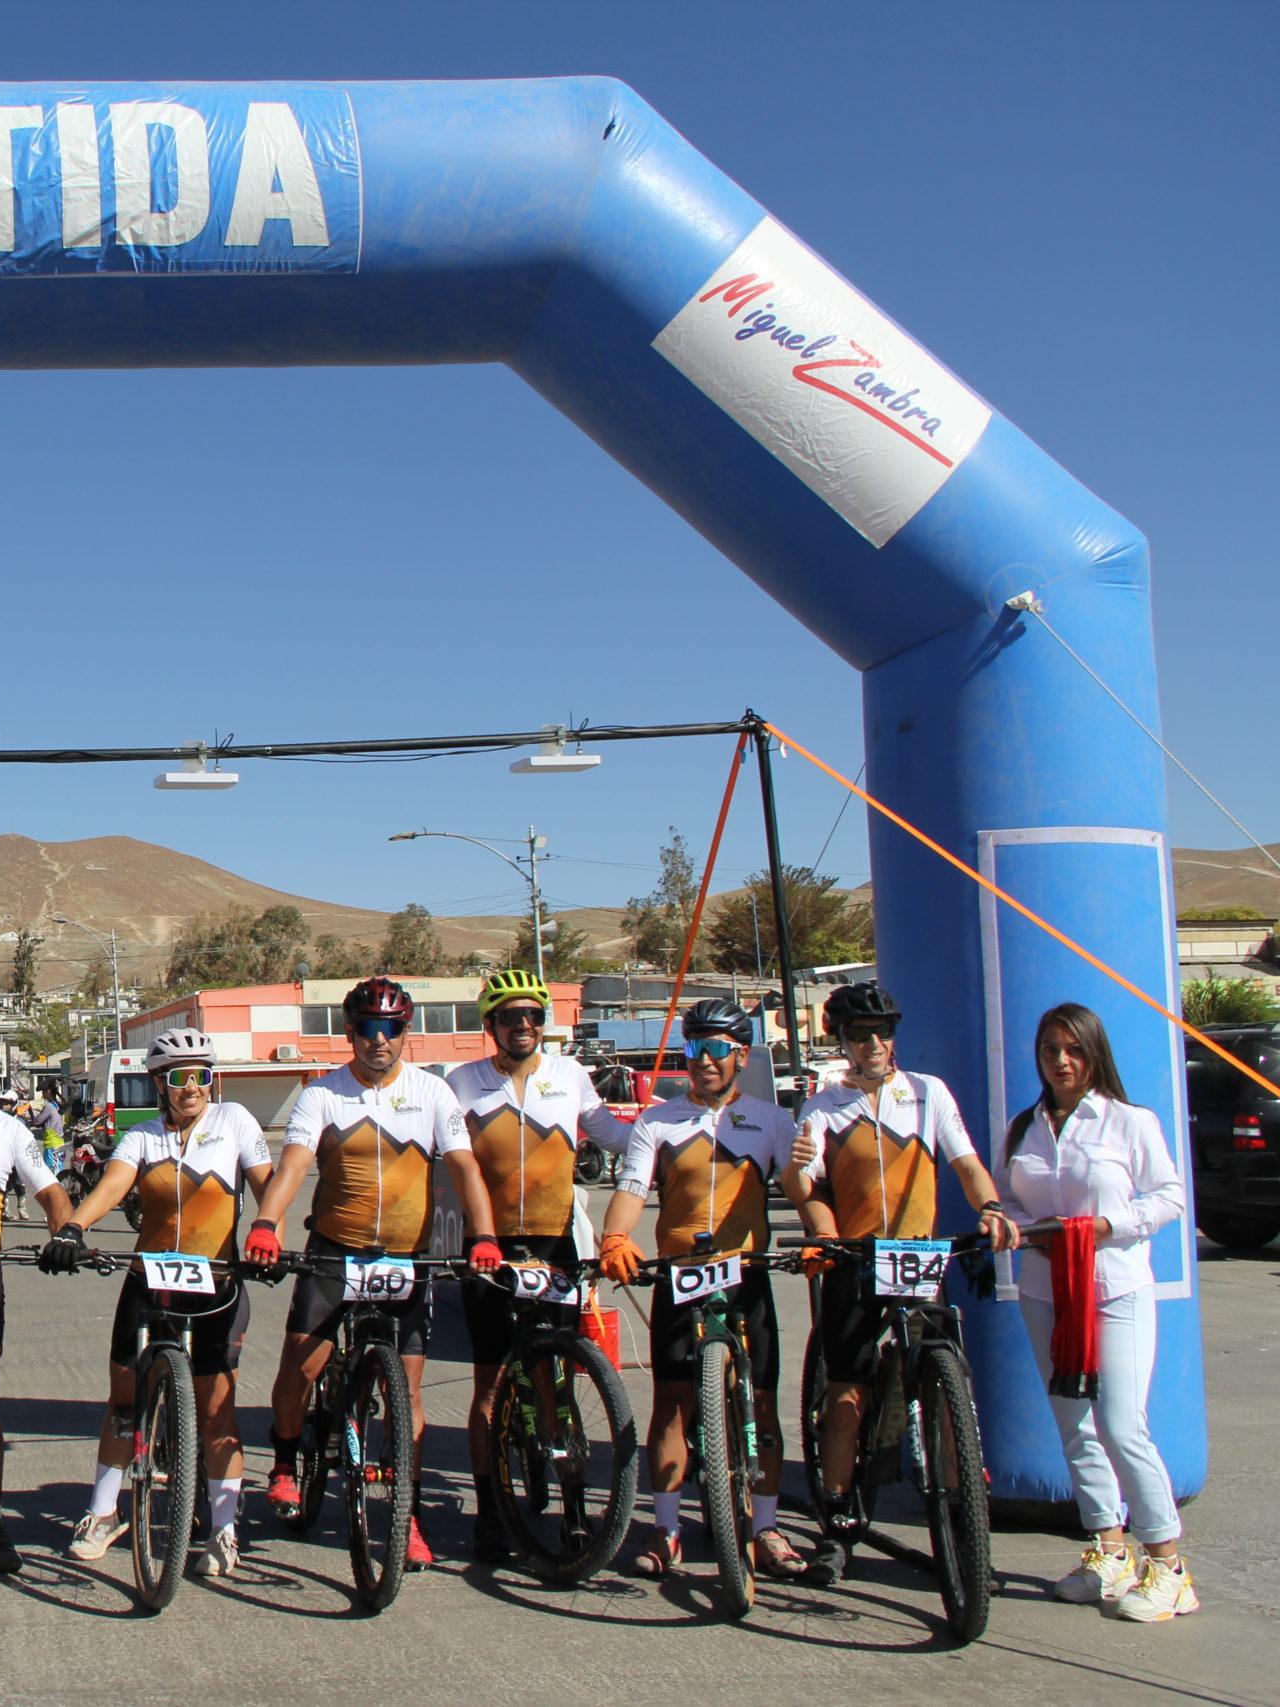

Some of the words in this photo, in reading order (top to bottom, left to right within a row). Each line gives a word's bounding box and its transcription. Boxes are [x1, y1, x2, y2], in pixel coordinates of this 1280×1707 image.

[698, 272, 838, 359] Miguel
[792, 339, 954, 469] Zambra
[155, 1262, 204, 1284] 173
[358, 1264, 406, 1294] 160
[675, 1261, 729, 1294] 011
[888, 1252, 943, 1285] 184
